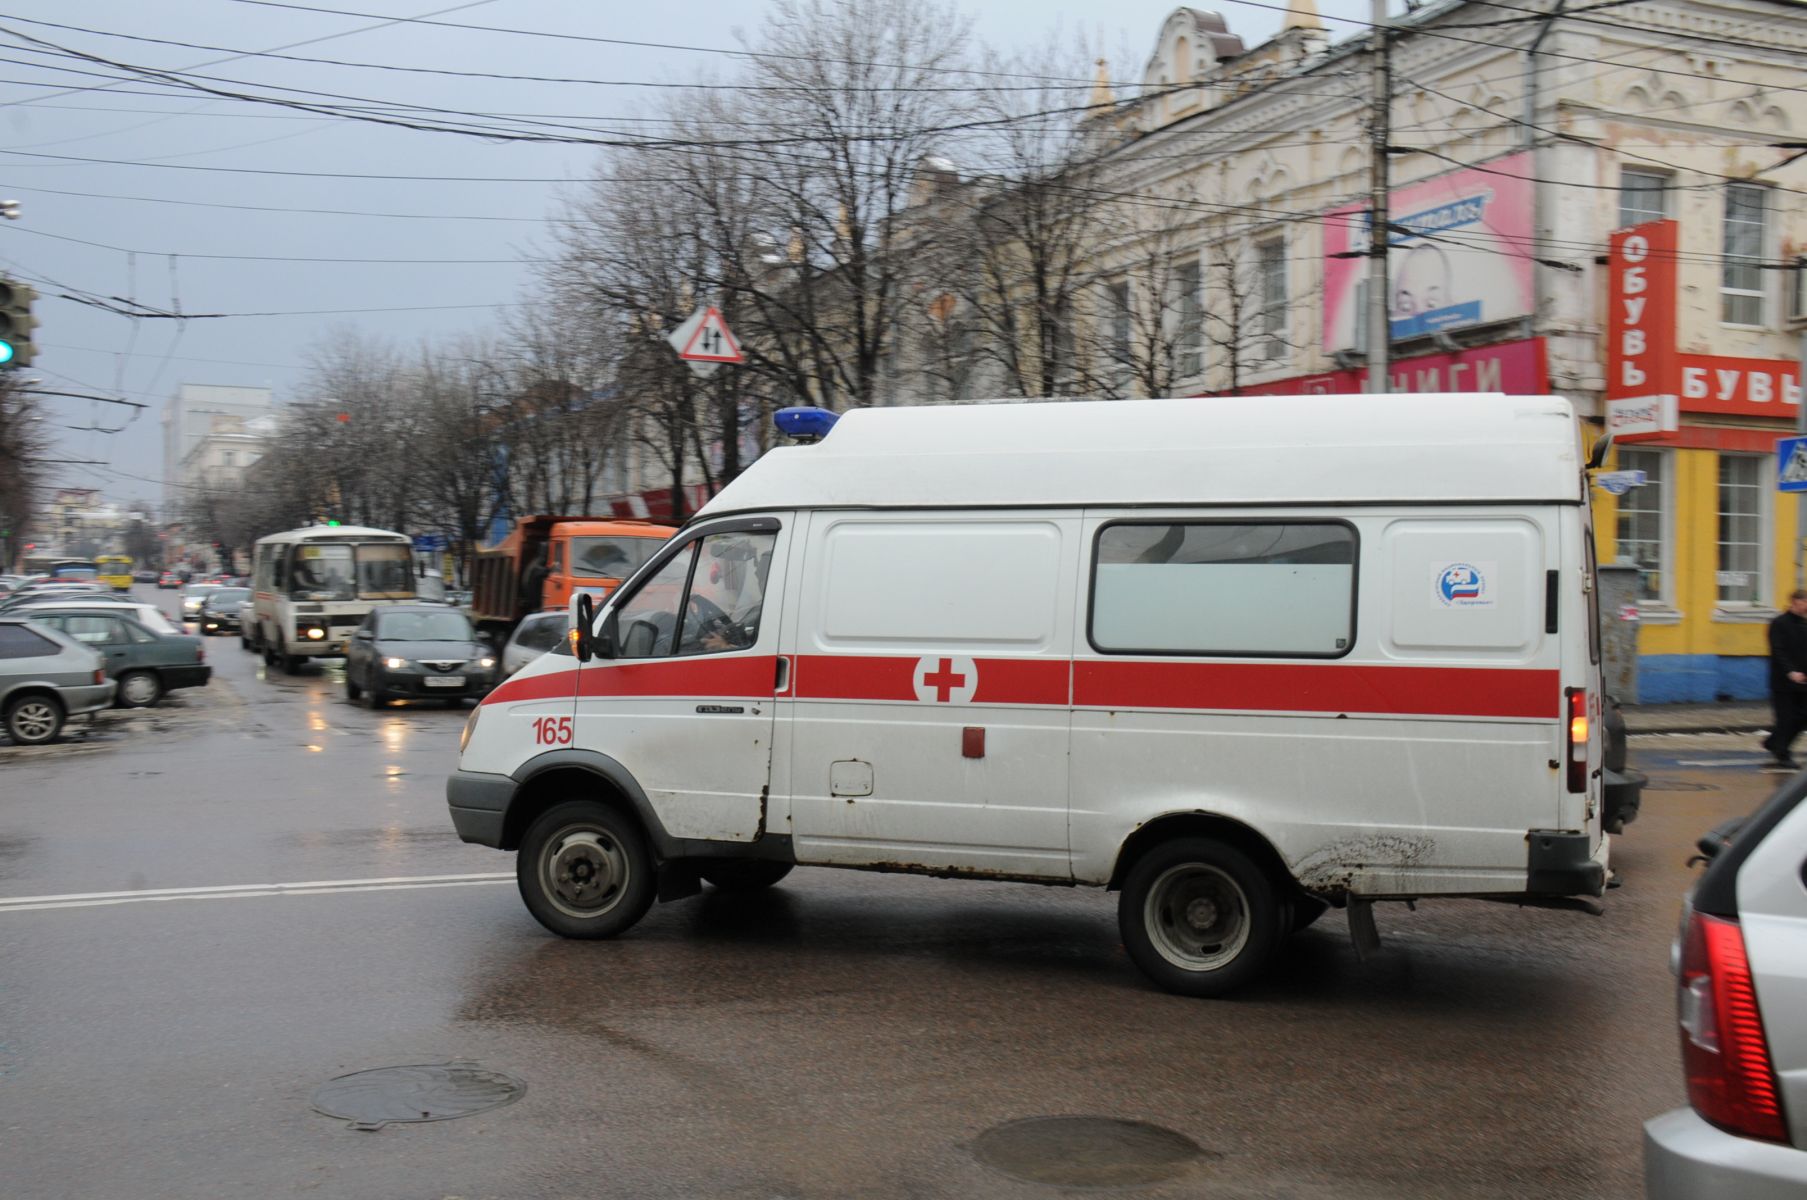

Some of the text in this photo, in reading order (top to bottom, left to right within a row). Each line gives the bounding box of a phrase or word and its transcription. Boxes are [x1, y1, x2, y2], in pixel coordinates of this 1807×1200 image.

[1622, 235, 1648, 387] ОБУВЬ
[1681, 366, 1801, 404] БУВЬ
[532, 717, 572, 745] 165
